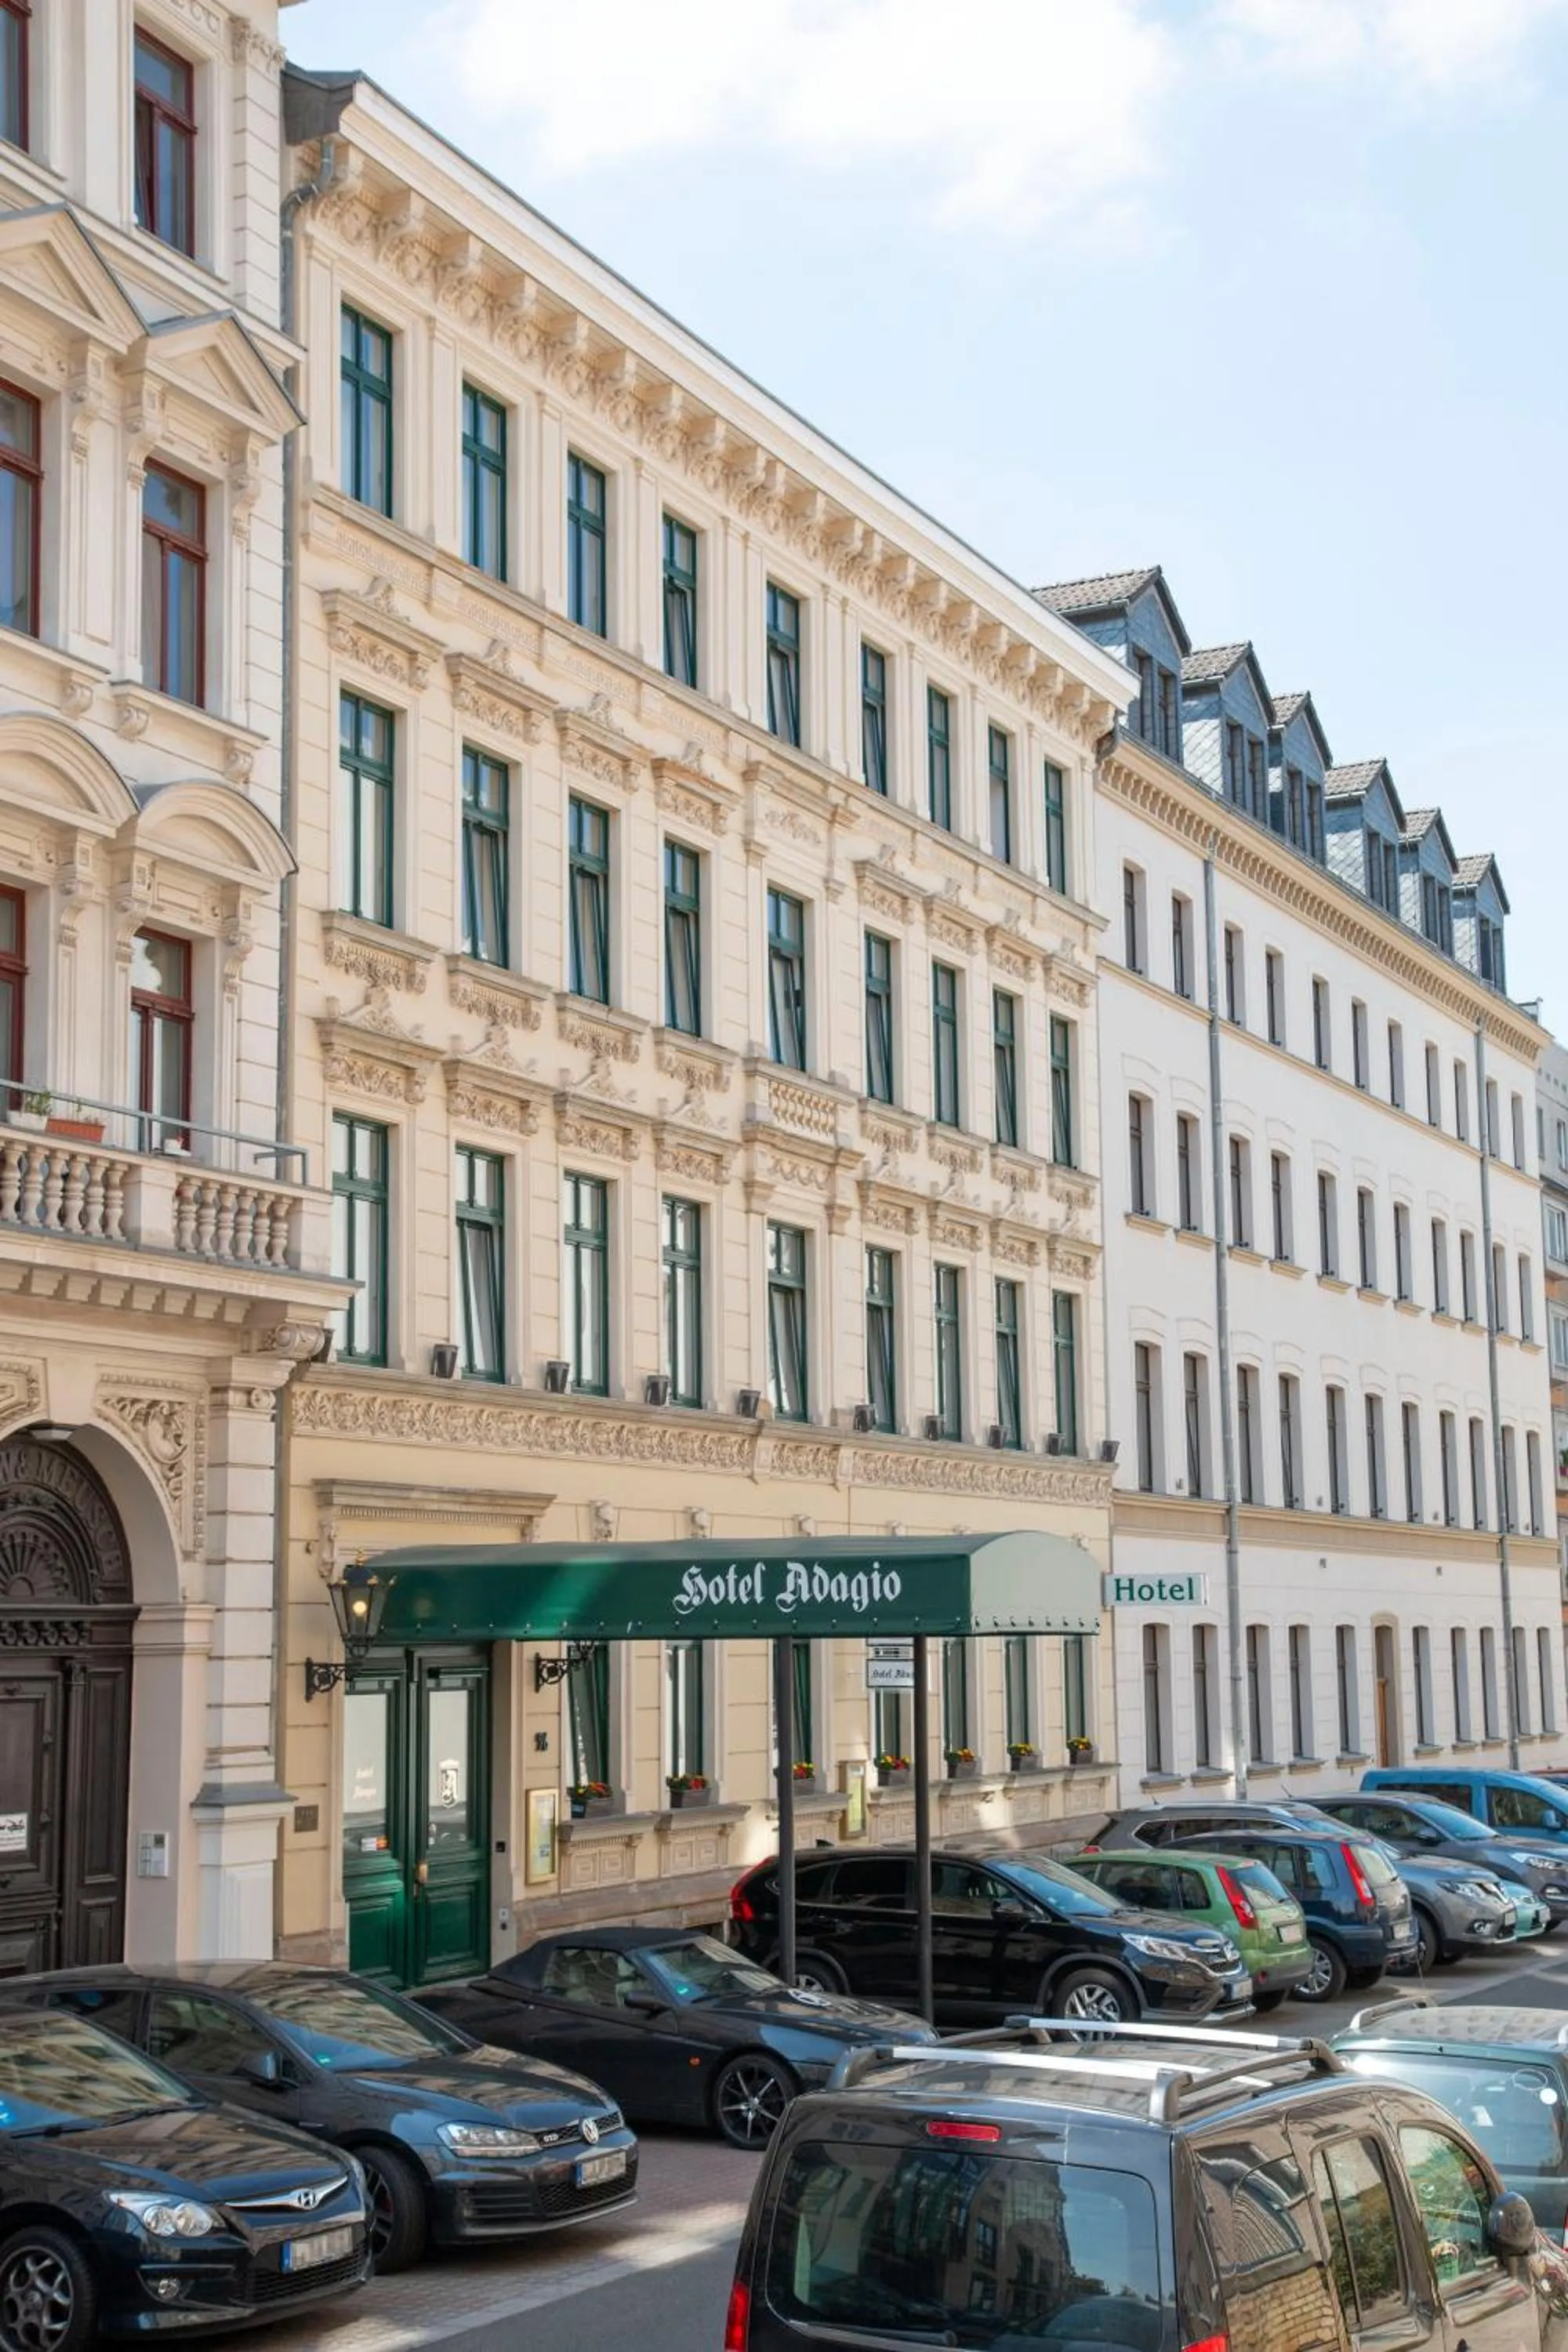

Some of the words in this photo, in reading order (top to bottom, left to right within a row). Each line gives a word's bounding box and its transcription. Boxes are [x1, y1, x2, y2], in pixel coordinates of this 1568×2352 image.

[673, 1562, 765, 1613] Hotel
[775, 1562, 901, 1612] Adagio
[1115, 1577, 1193, 1601] Hotel
